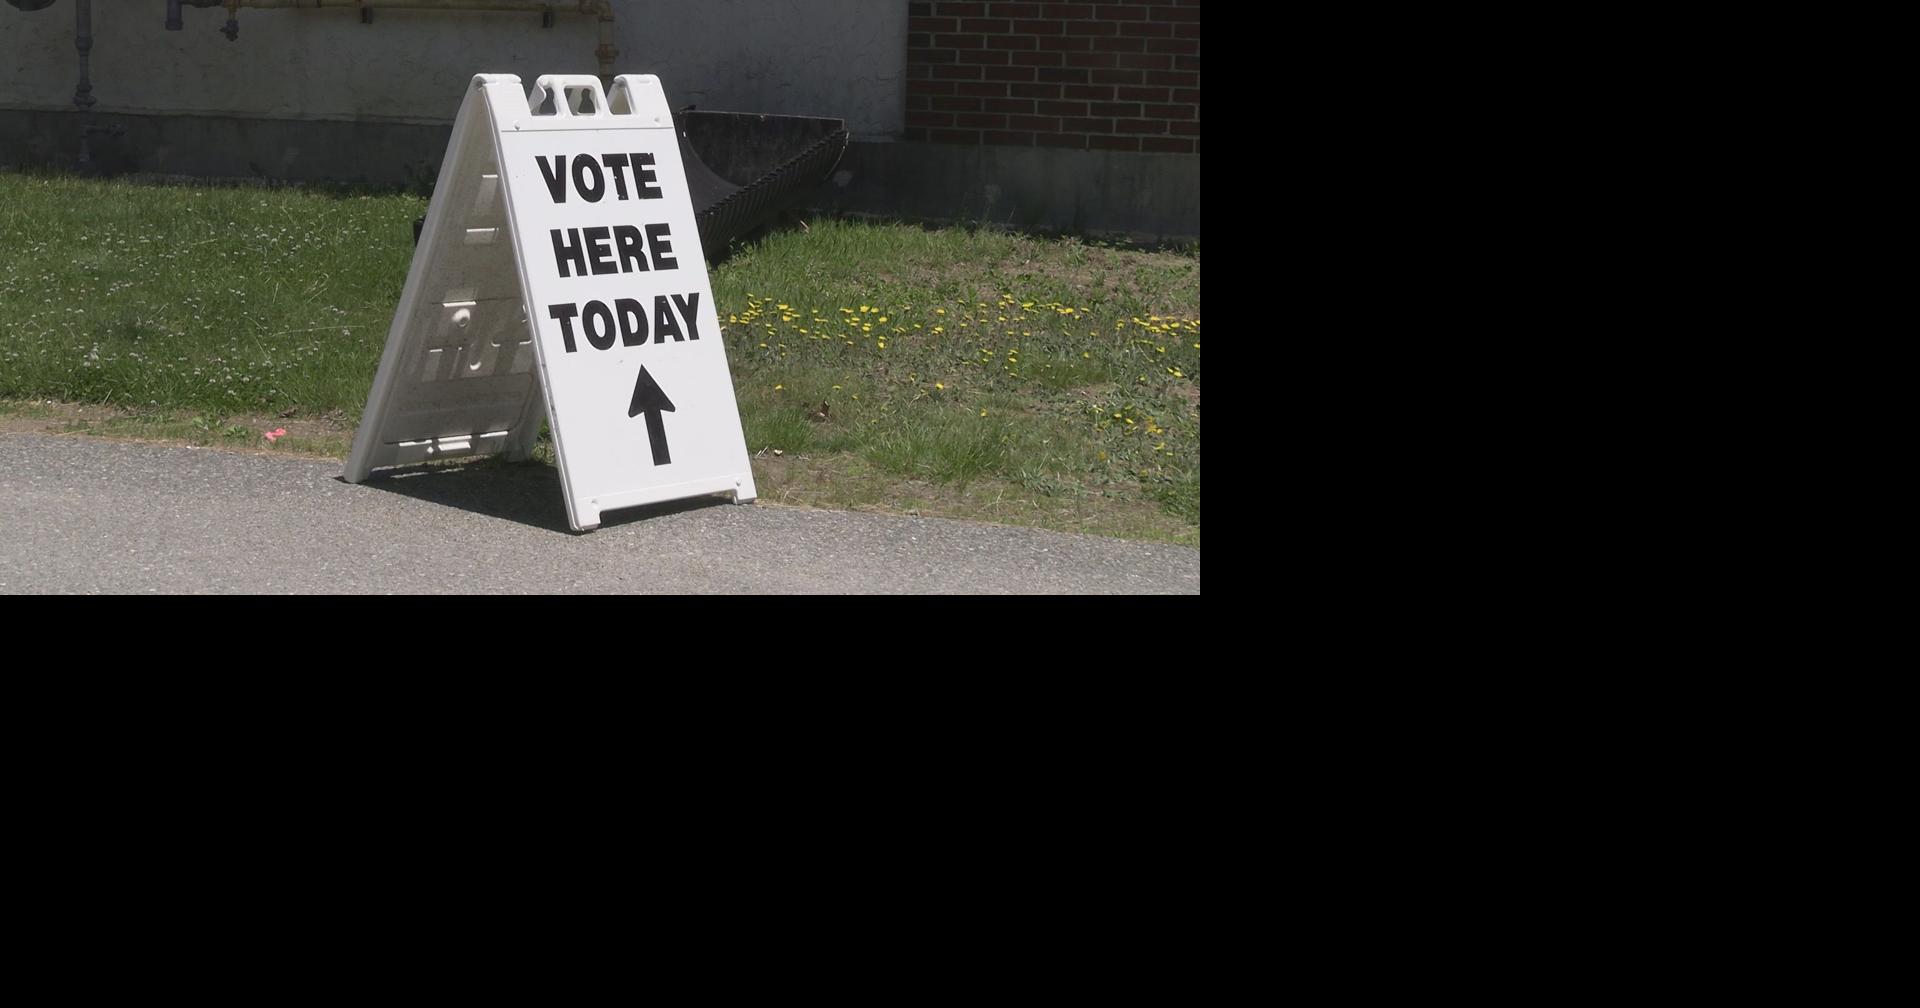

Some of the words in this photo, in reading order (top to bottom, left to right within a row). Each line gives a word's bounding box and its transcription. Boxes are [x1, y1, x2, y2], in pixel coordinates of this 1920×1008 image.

[535, 153, 663, 203] VOTE
[550, 223, 678, 277] HERE
[548, 293, 700, 353] TODAY
